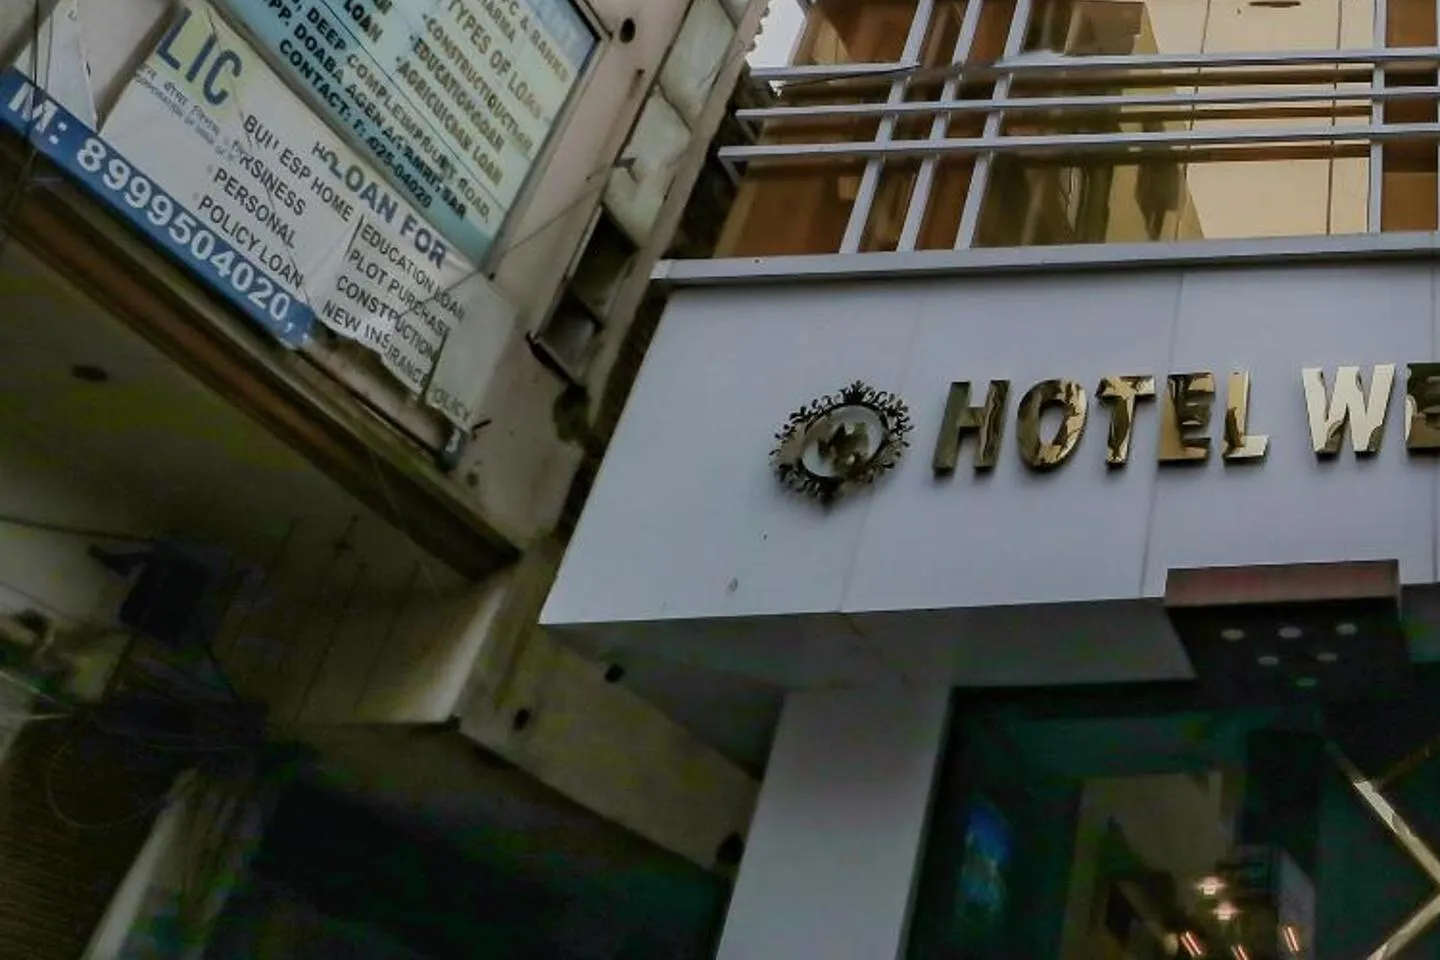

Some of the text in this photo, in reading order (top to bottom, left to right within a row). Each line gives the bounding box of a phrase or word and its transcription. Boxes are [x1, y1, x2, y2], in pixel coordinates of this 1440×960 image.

[306, 7, 346, 50] DEEP
[519, 15, 529, 32] &
[156, 8, 241, 104] LIC
[279, 39, 350, 120] CONTACT:
[293, 23, 342, 84] DOABA
[489, 49, 511, 75] OF
[213, 168, 294, 248] PERSONAL
[310, 176, 353, 221] HOME
[198, 194, 303, 288] POLICY LOAN
[348, 248, 387, 284] PLOT
[399, 214, 446, 268] FOR
[360, 223, 465, 321] EDUCATION LOAN
[322, 299, 361, 330] NEW
[931, 371, 1269, 475] HOTEL
